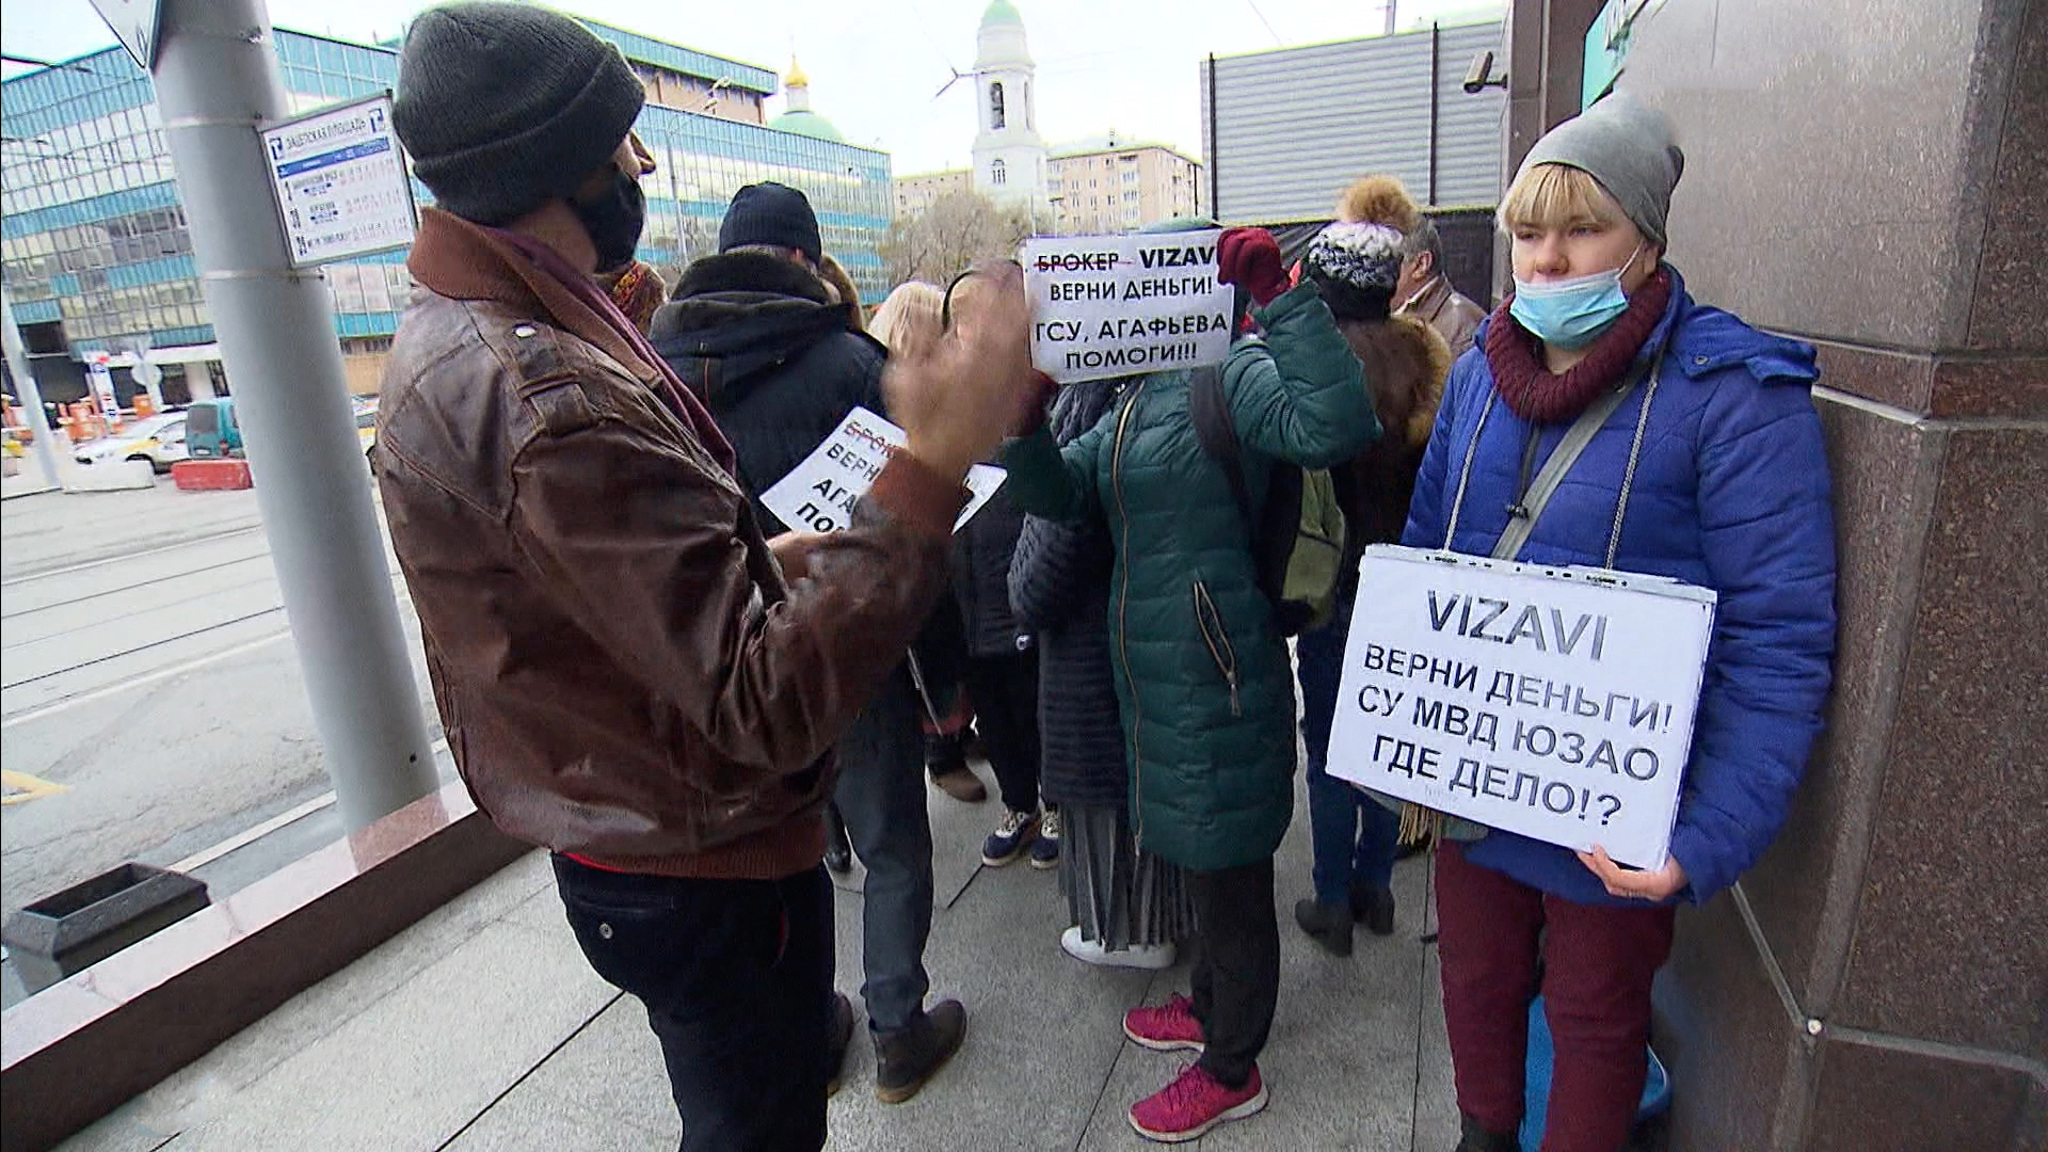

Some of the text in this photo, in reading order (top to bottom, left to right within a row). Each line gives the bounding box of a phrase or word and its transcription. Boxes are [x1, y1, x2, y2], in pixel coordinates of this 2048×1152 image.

[1037, 246, 1215, 273] БРОКЕР VIZAV
[1050, 277, 1212, 301] ВЕРНИ ДЕНЬГИ!
[1036, 313, 1227, 342] ГСУ, АГАФЬЕВА
[1066, 343, 1197, 369] ПОМОГИ!!!
[827, 443, 881, 481] ВЕРН
[812, 479, 856, 514] АГА
[796, 502, 846, 533] ПО
[1427, 589, 1607, 661] VIZAVI
[1364, 643, 1672, 734] ВЕРНИ ДЕНЬГИ!
[1358, 685, 1659, 781] СУ МВД ЮЗАО
[1373, 735, 1621, 827] ГДЕ ДЕЛО!?
